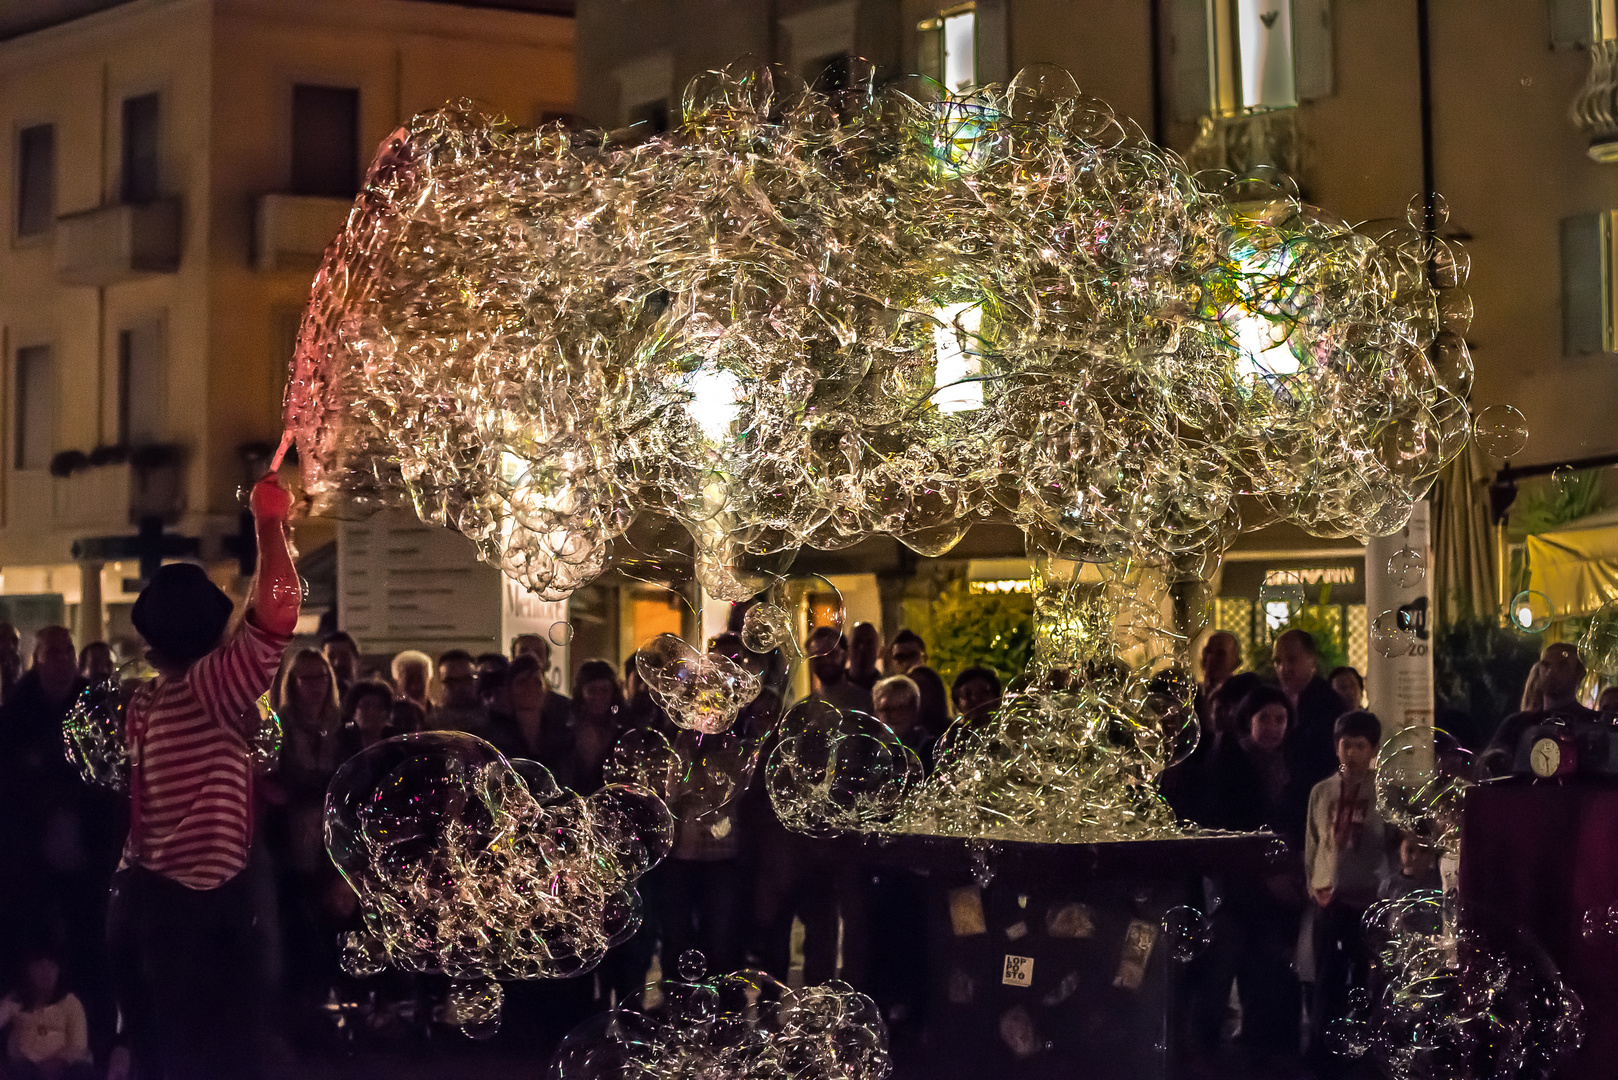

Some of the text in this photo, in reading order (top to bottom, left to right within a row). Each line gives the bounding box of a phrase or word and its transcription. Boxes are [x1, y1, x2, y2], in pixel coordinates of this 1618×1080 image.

[1007, 956, 1027, 966] LOP
[1006, 963, 1020, 972] PO
[1005, 970, 1026, 980] STO
